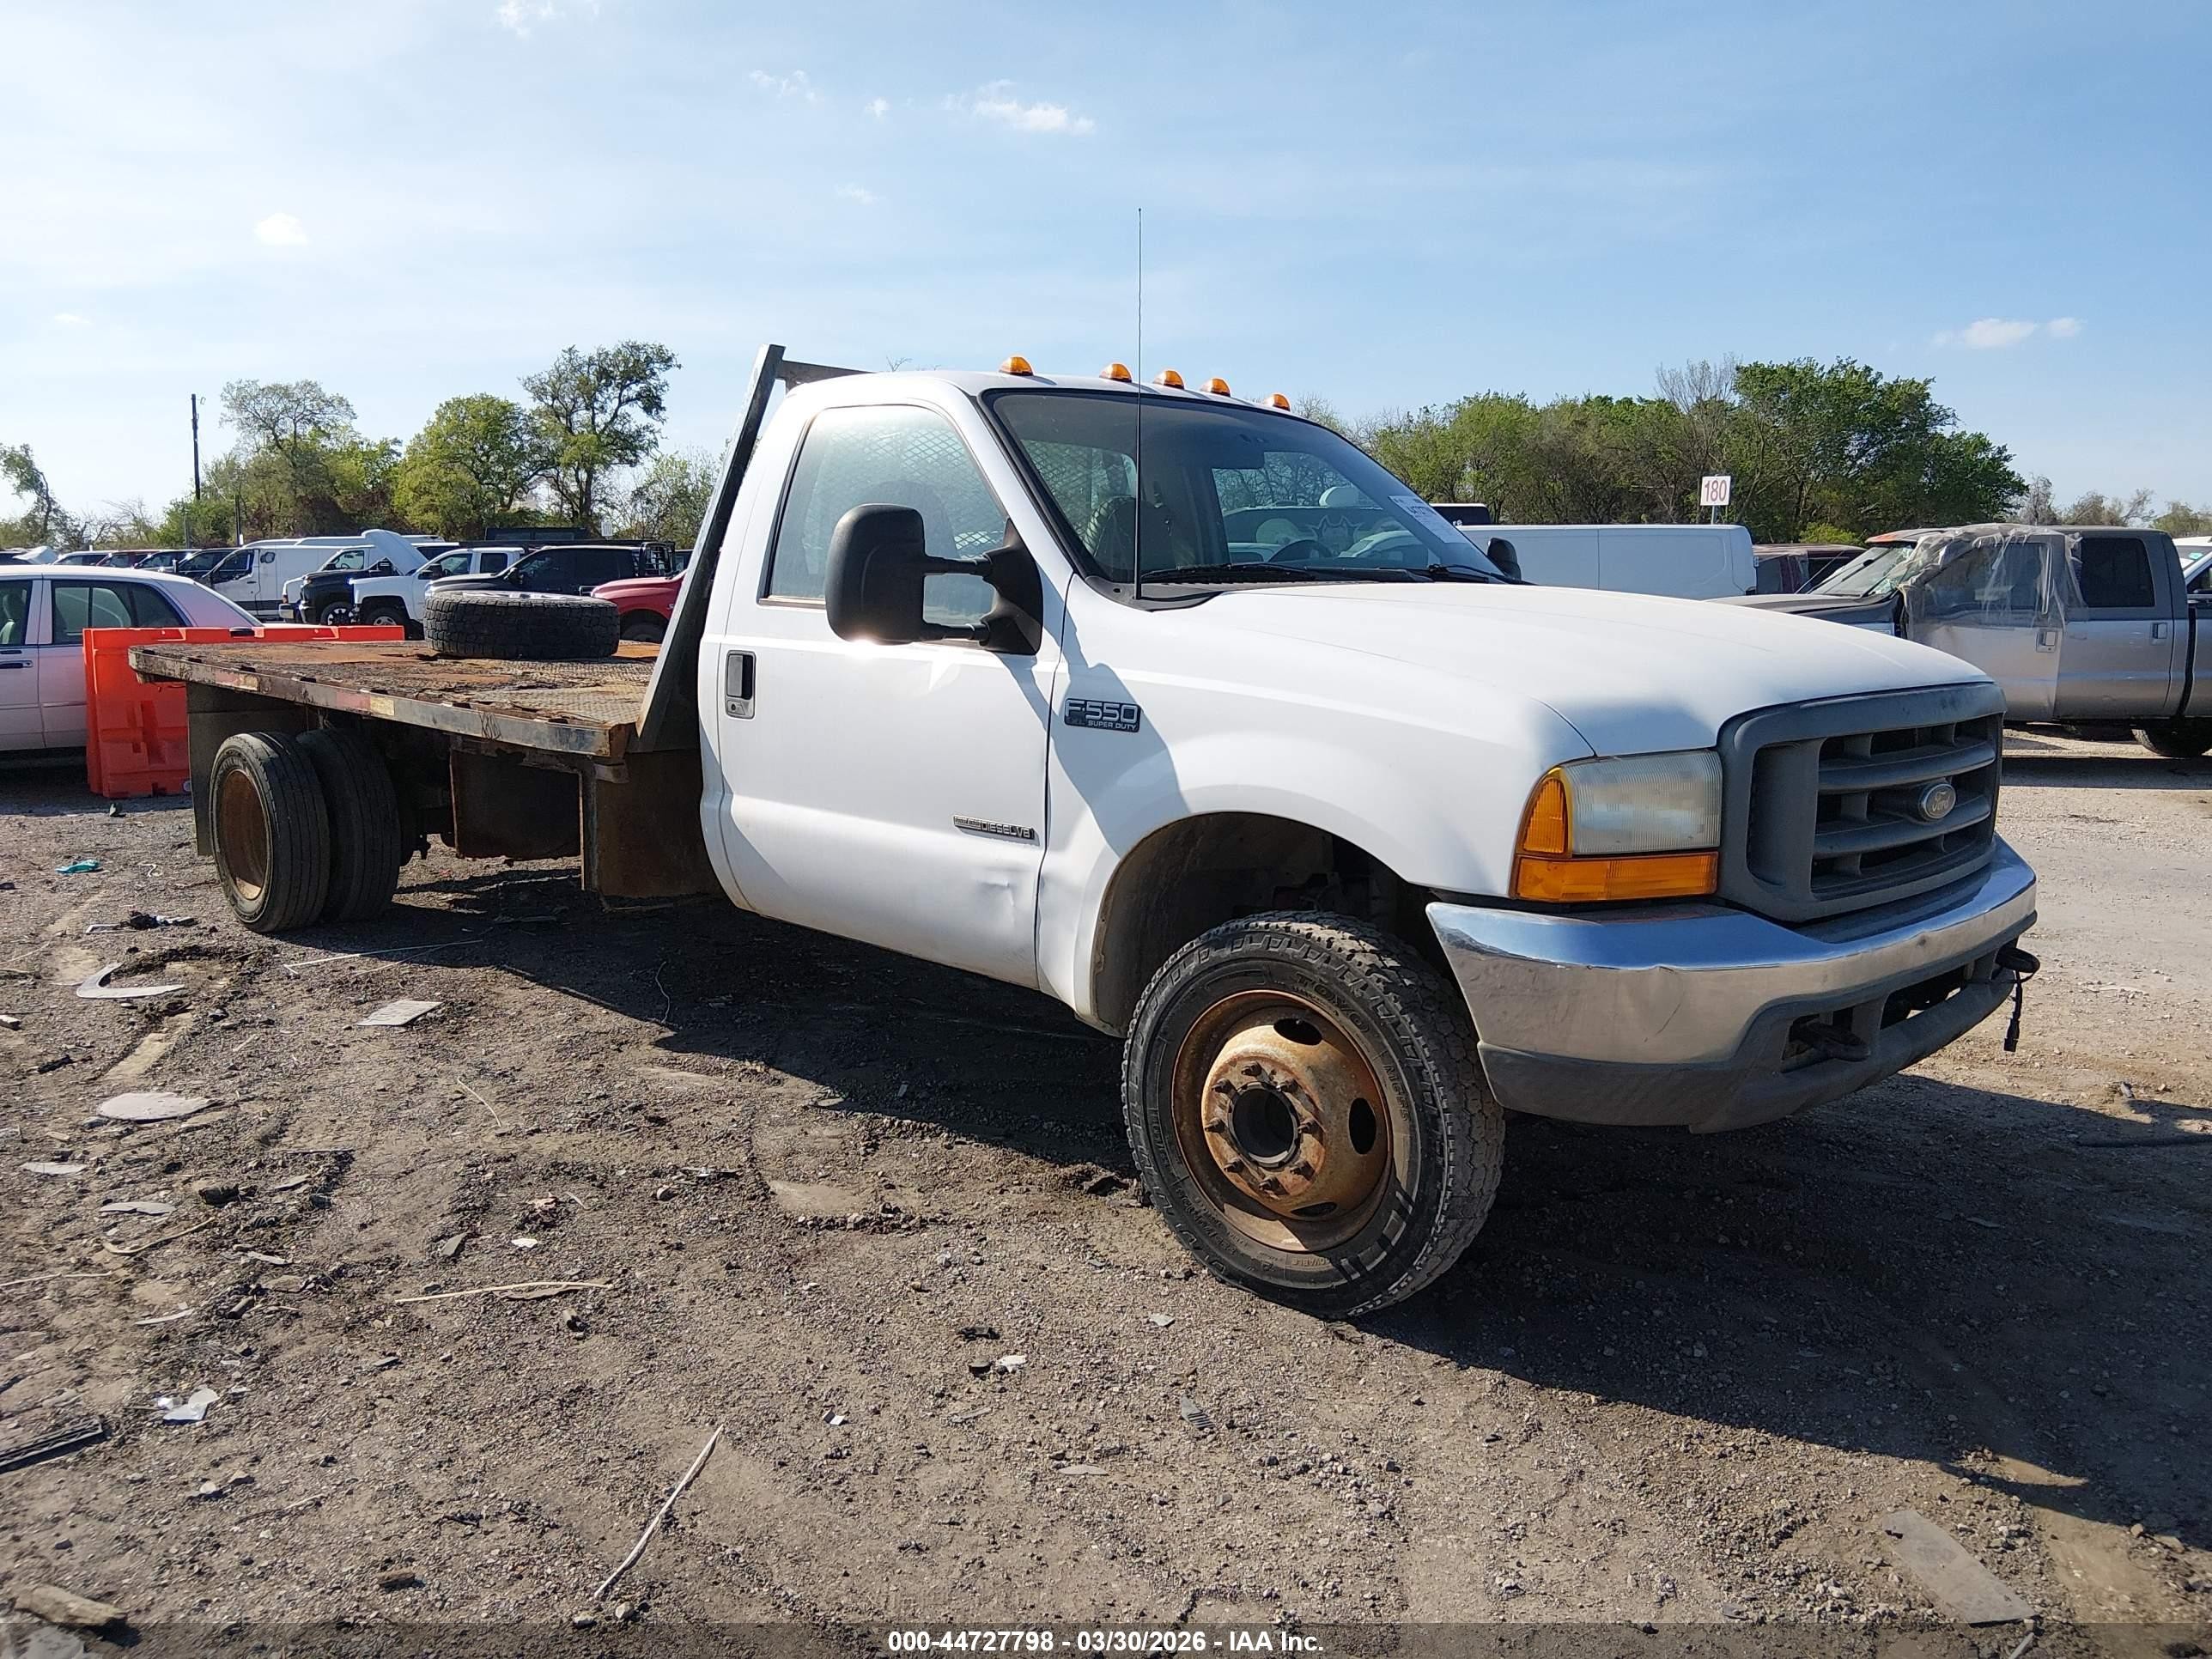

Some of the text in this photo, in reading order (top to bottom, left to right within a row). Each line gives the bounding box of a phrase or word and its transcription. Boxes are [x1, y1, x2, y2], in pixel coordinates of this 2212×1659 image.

[1704, 479, 1728, 502] 180
[1087, 720, 1138, 732] SUPER DUTY
[980, 822, 1018, 836] DIESEL
[1295, 970, 1370, 1034] TOYO
